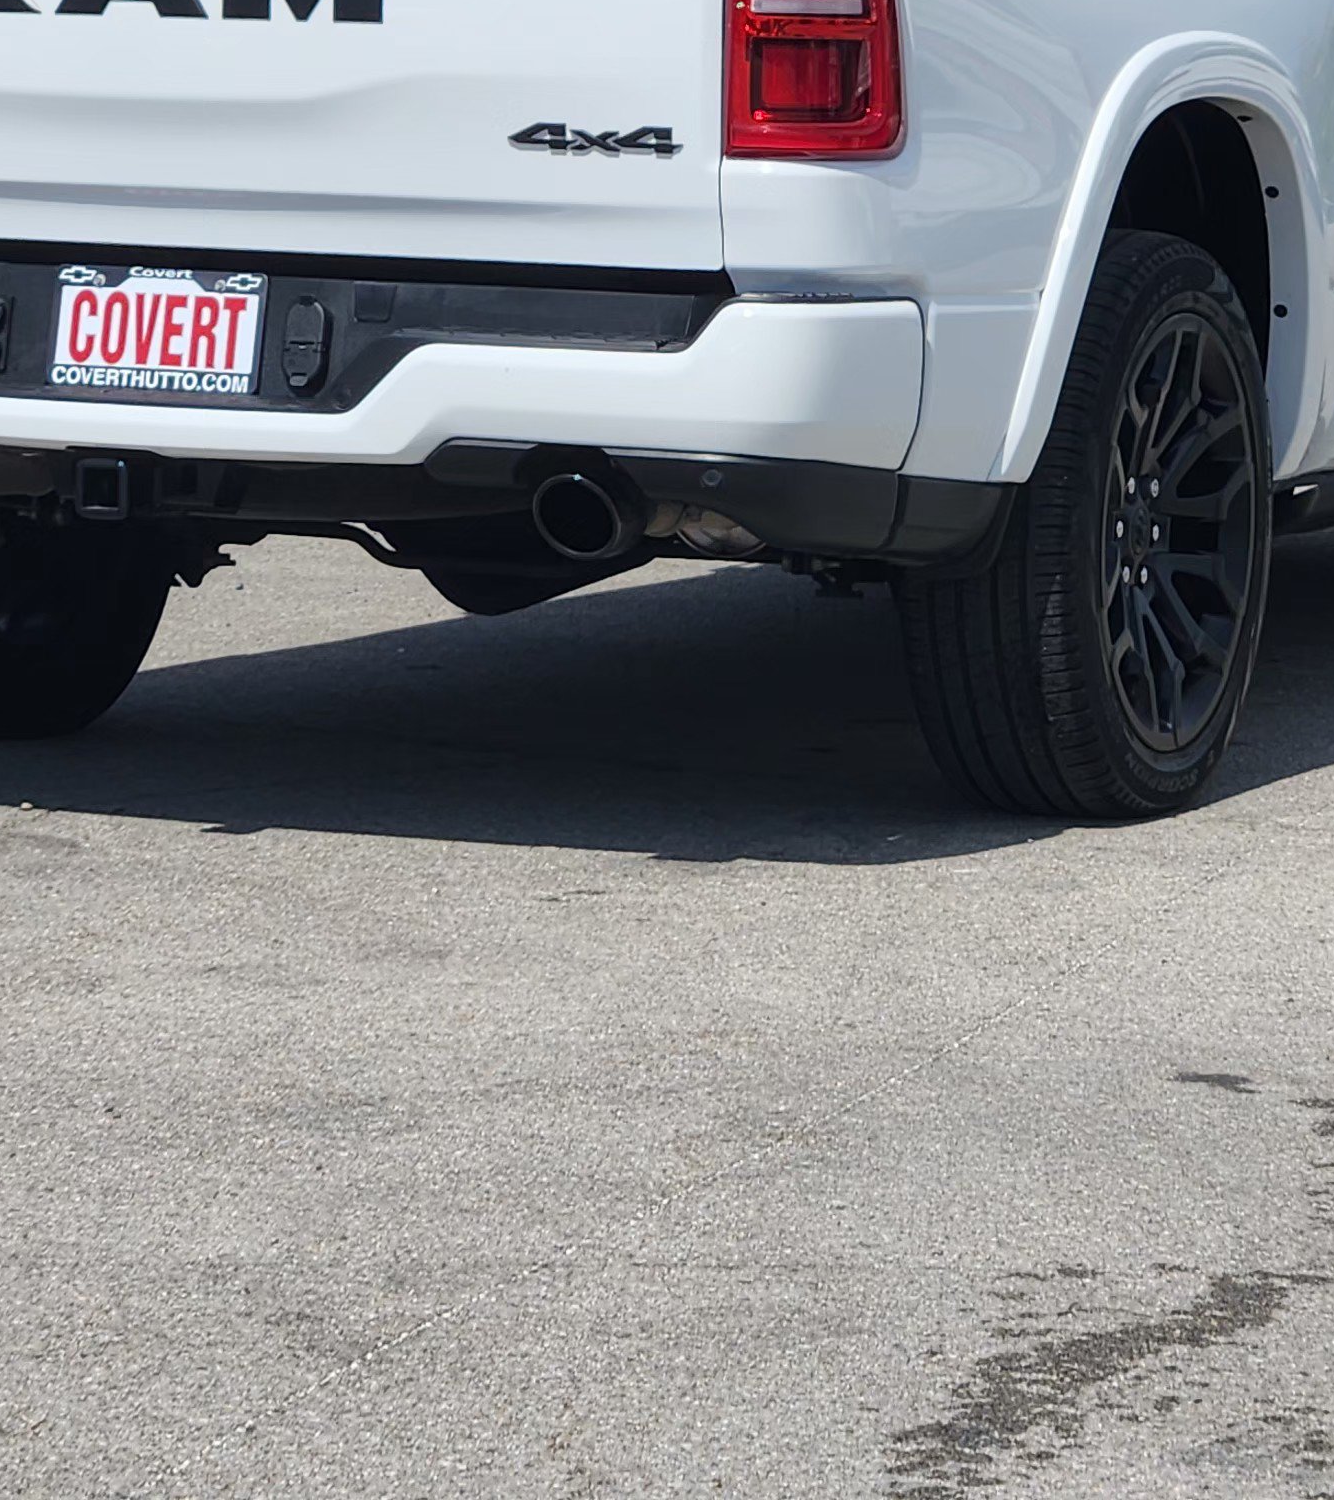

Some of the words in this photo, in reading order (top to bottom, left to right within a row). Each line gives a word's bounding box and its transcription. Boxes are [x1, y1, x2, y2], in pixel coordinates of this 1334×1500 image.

[508, 122, 683, 158] 4x4
[128, 266, 194, 279] Covert
[69, 288, 248, 370] COVERT
[51, 365, 250, 394] COVERTHUTTO.COM
